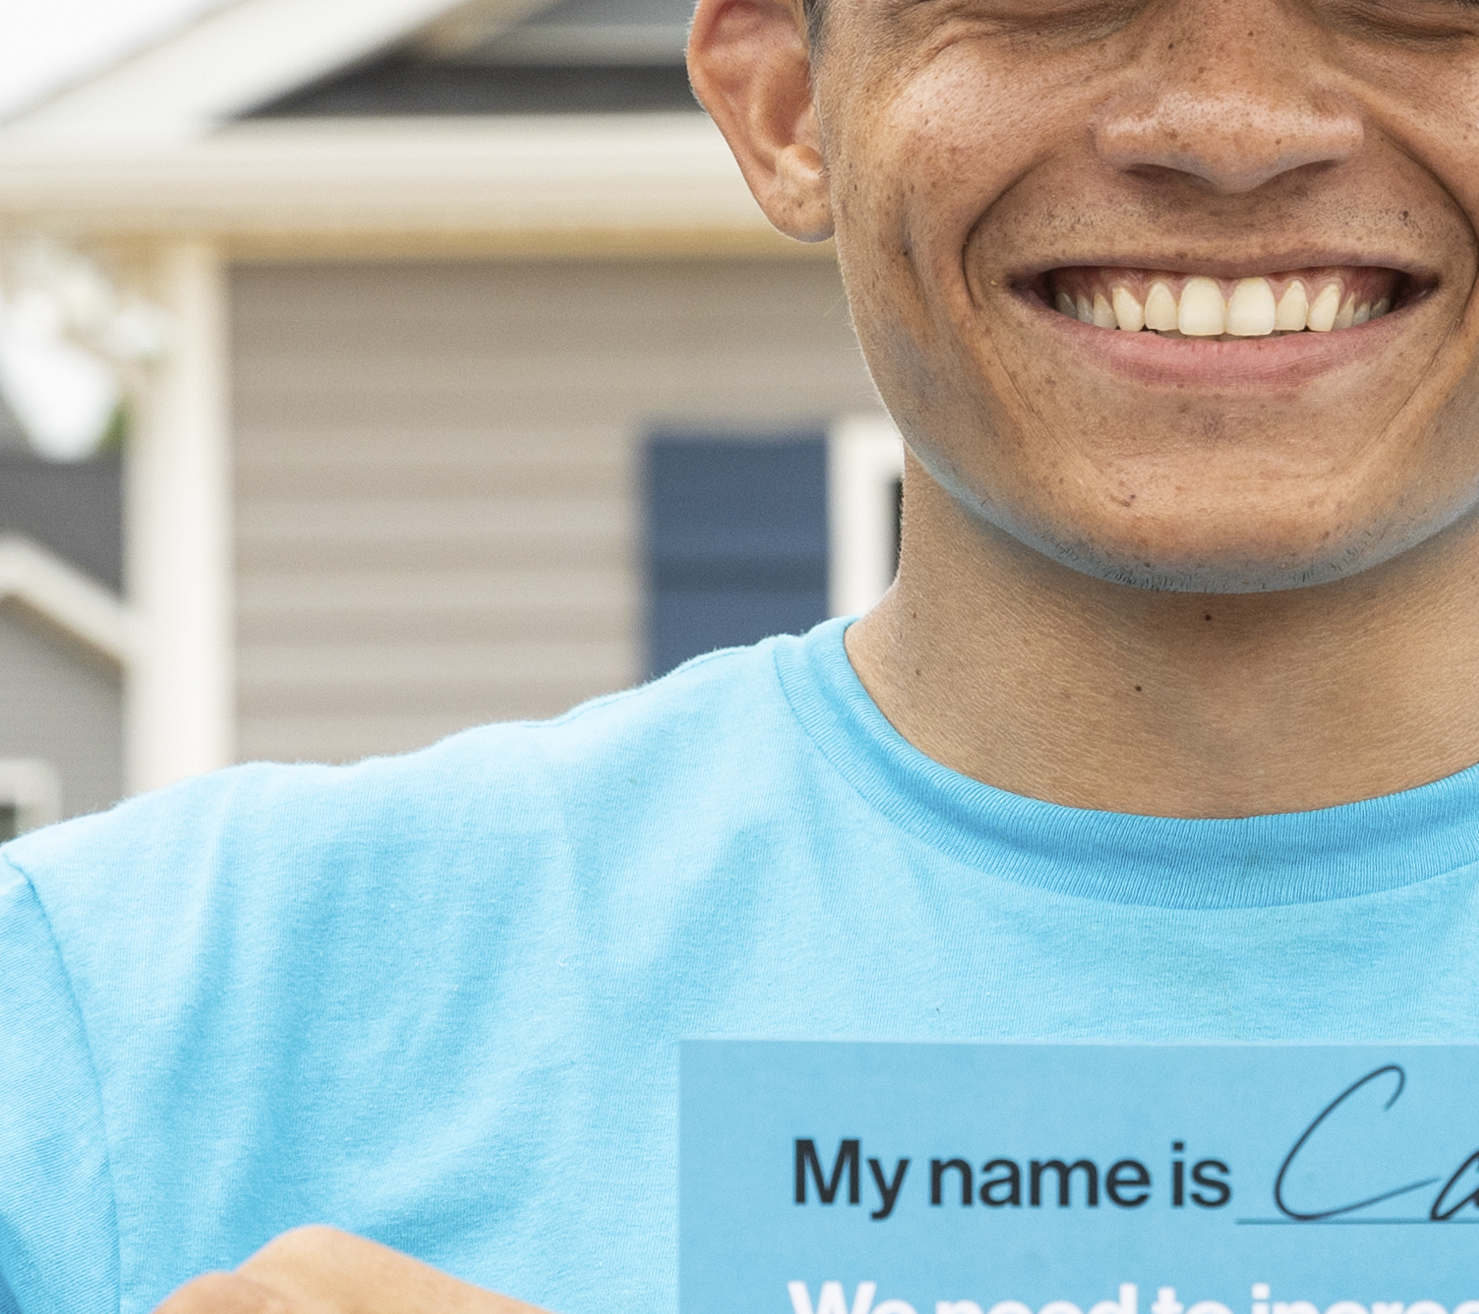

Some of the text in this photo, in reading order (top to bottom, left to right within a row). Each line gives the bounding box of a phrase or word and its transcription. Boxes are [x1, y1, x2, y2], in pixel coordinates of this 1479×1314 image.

[794, 1137, 911, 1222] My
[929, 1157, 1152, 1209] name
[1171, 1140, 1232, 1209] is
